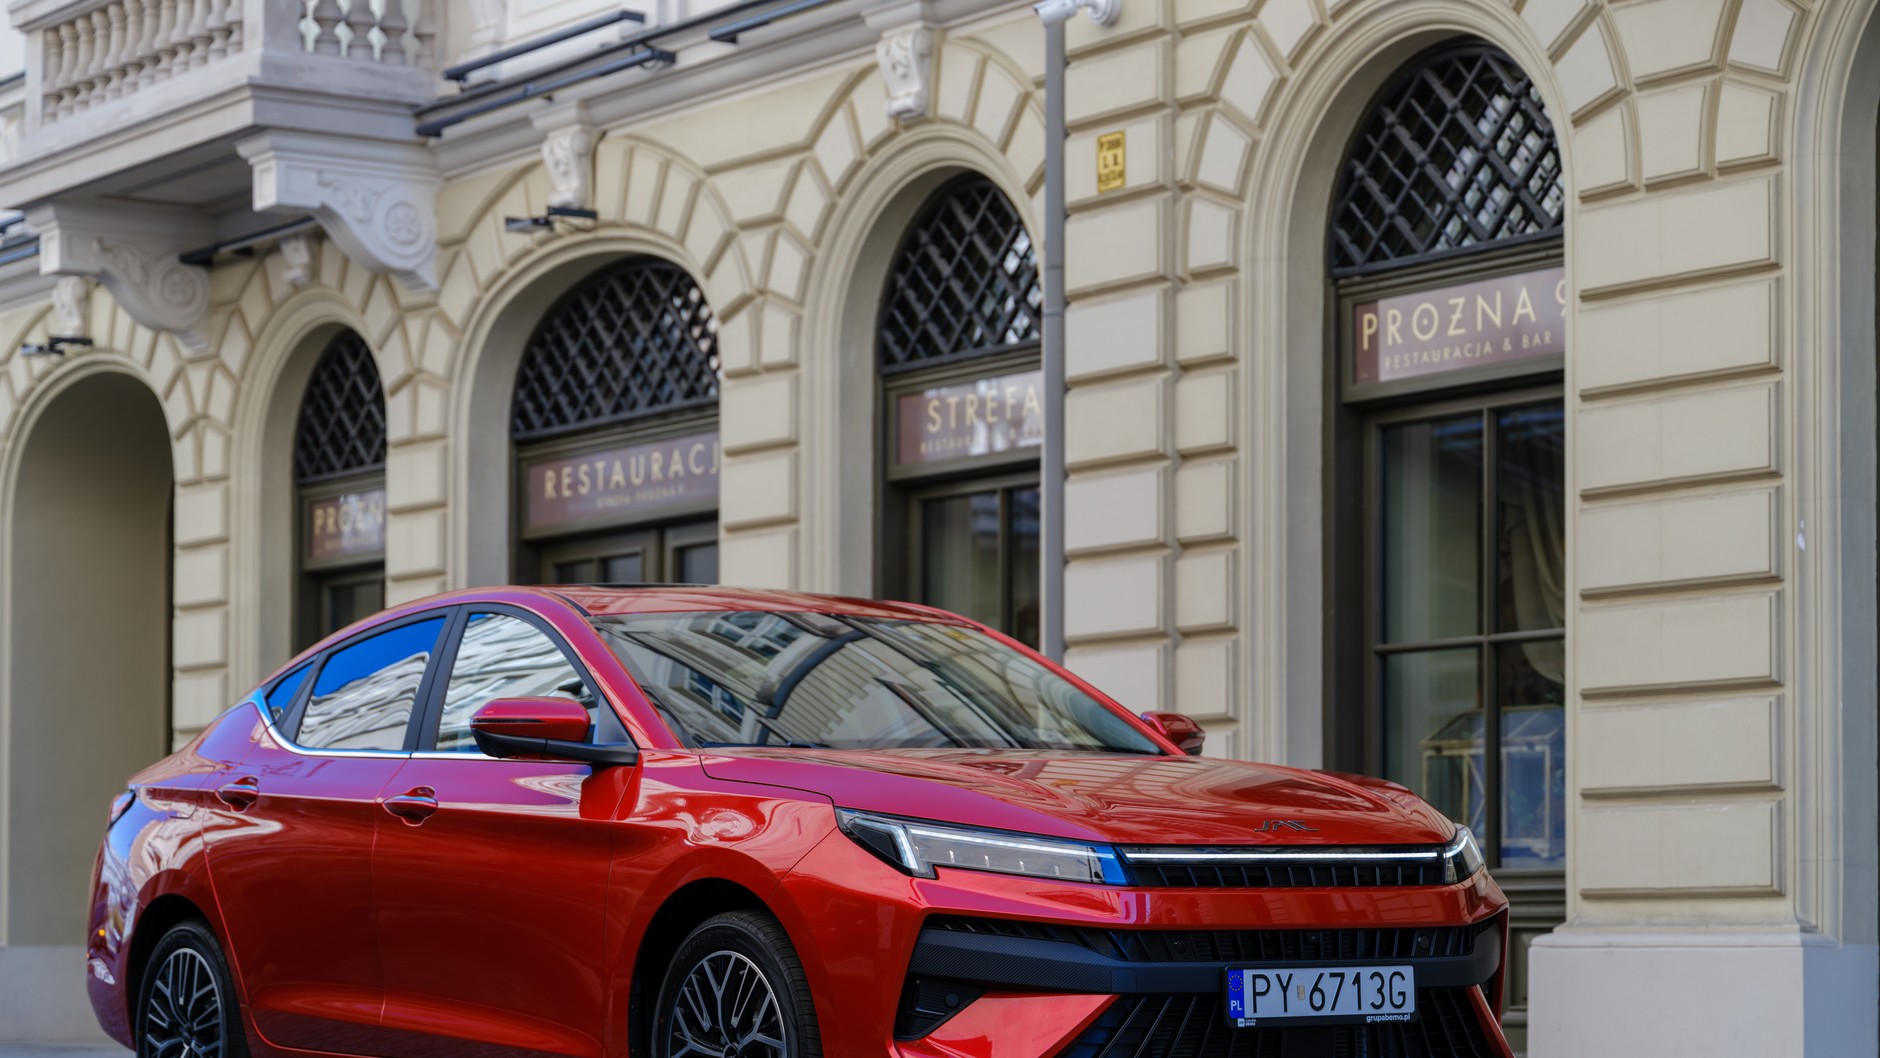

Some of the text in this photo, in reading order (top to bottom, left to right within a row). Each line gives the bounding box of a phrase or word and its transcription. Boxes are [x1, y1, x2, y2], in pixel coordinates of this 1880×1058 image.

[1385, 331, 1552, 370] RESTAURACJA & BAR
[927, 384, 1041, 434] STREFA
[1230, 1000, 1243, 1011] PL
[1252, 971, 1407, 1014] PY 6713G
[1366, 1012, 1411, 1023] grupabemo.pl
